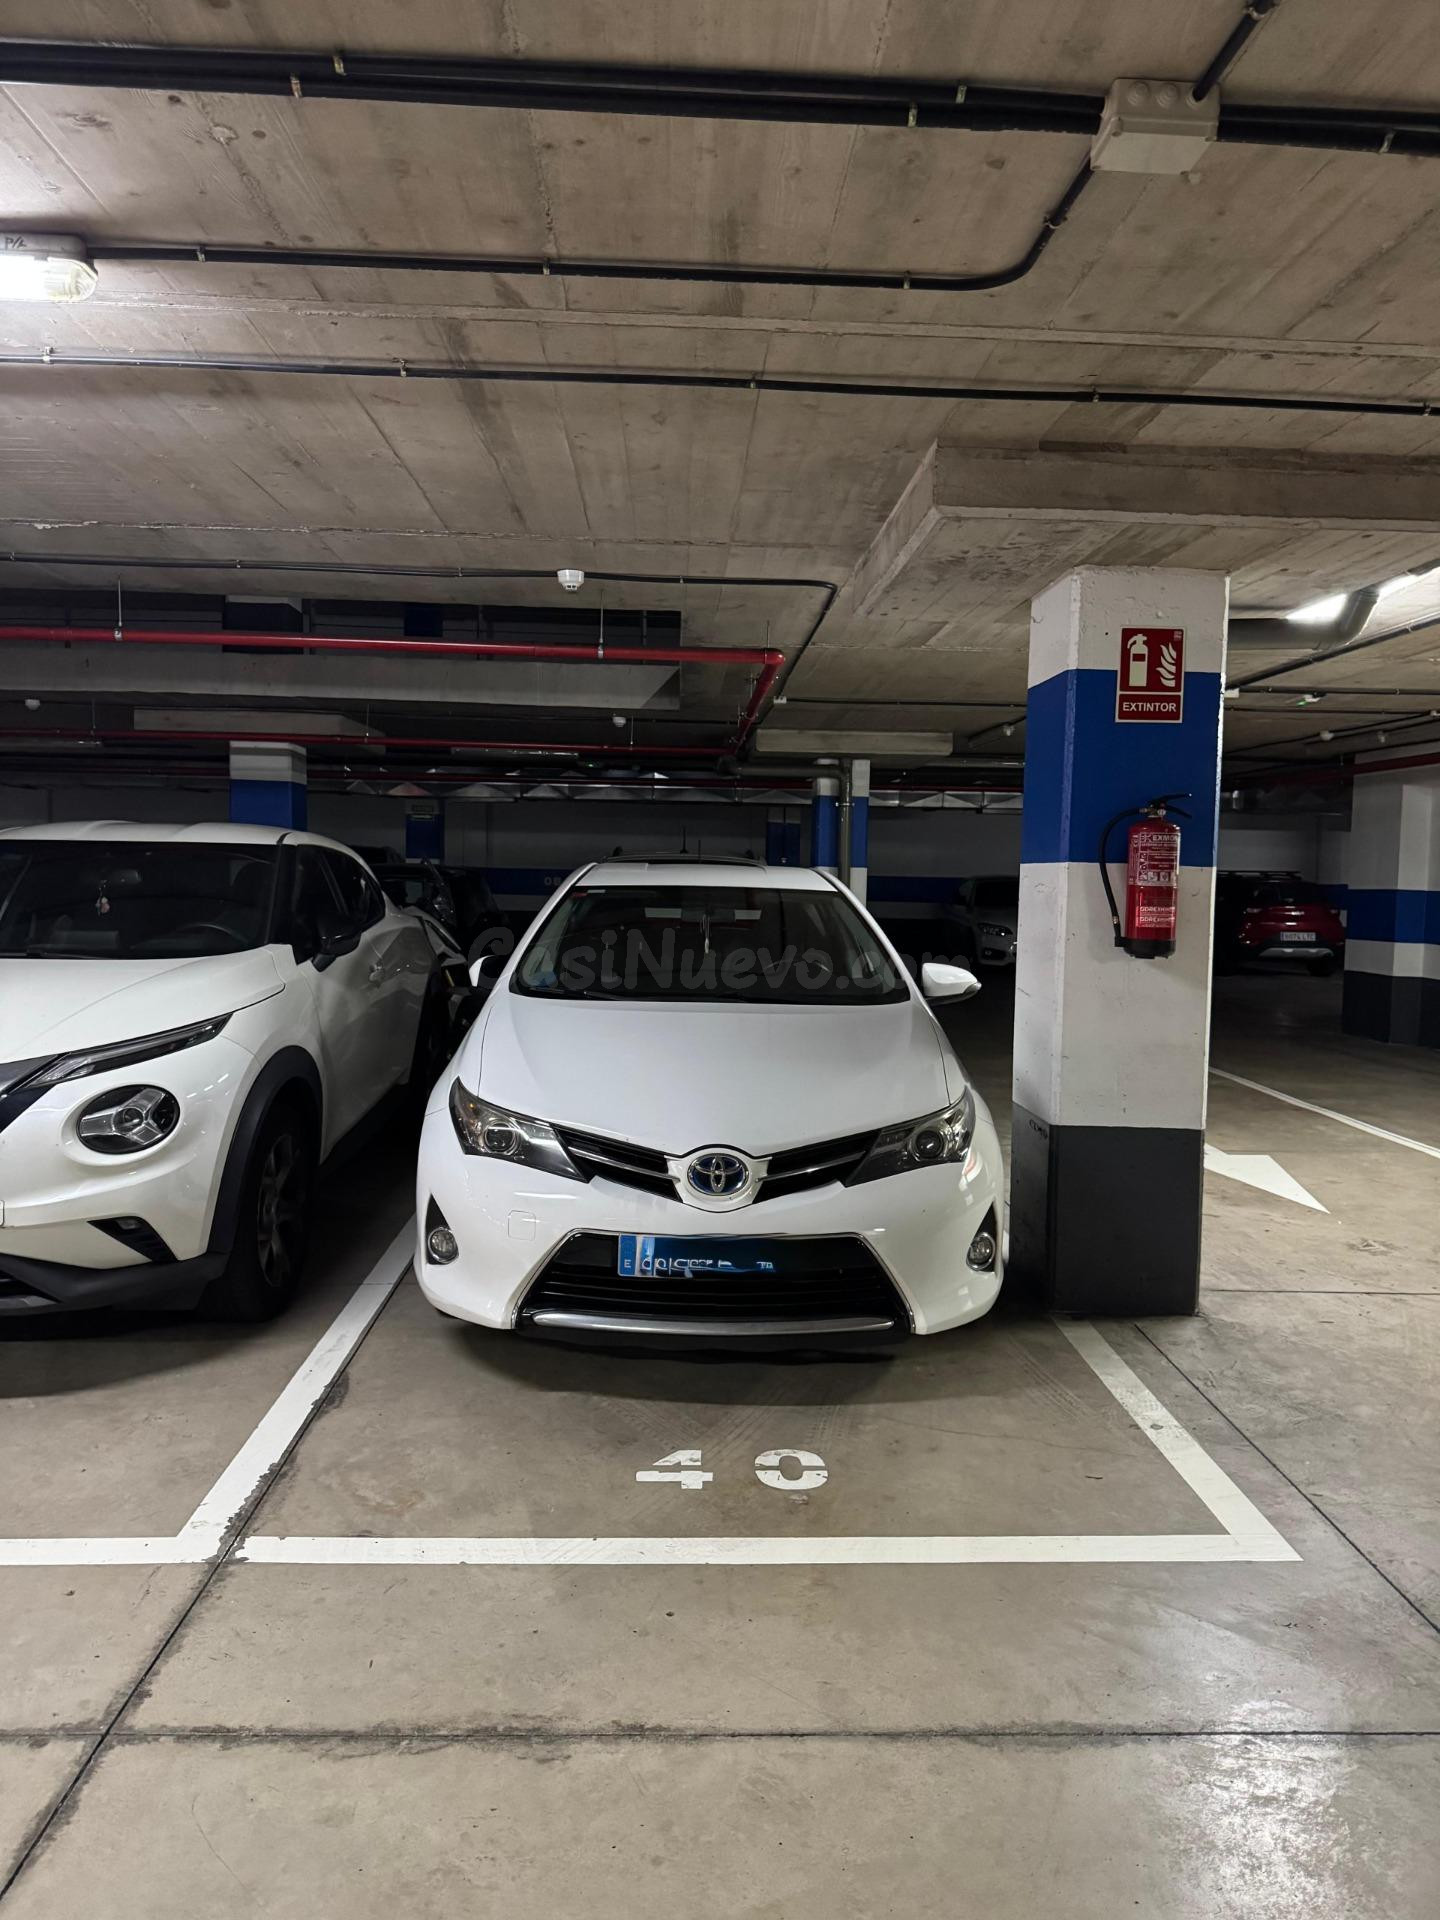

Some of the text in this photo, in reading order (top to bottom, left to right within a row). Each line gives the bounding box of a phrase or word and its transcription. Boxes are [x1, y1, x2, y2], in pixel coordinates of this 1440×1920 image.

[1122, 702, 1177, 712] EXTINTOR
[624, 1259, 632, 1268] E
[635, 1448, 829, 1490] 40
